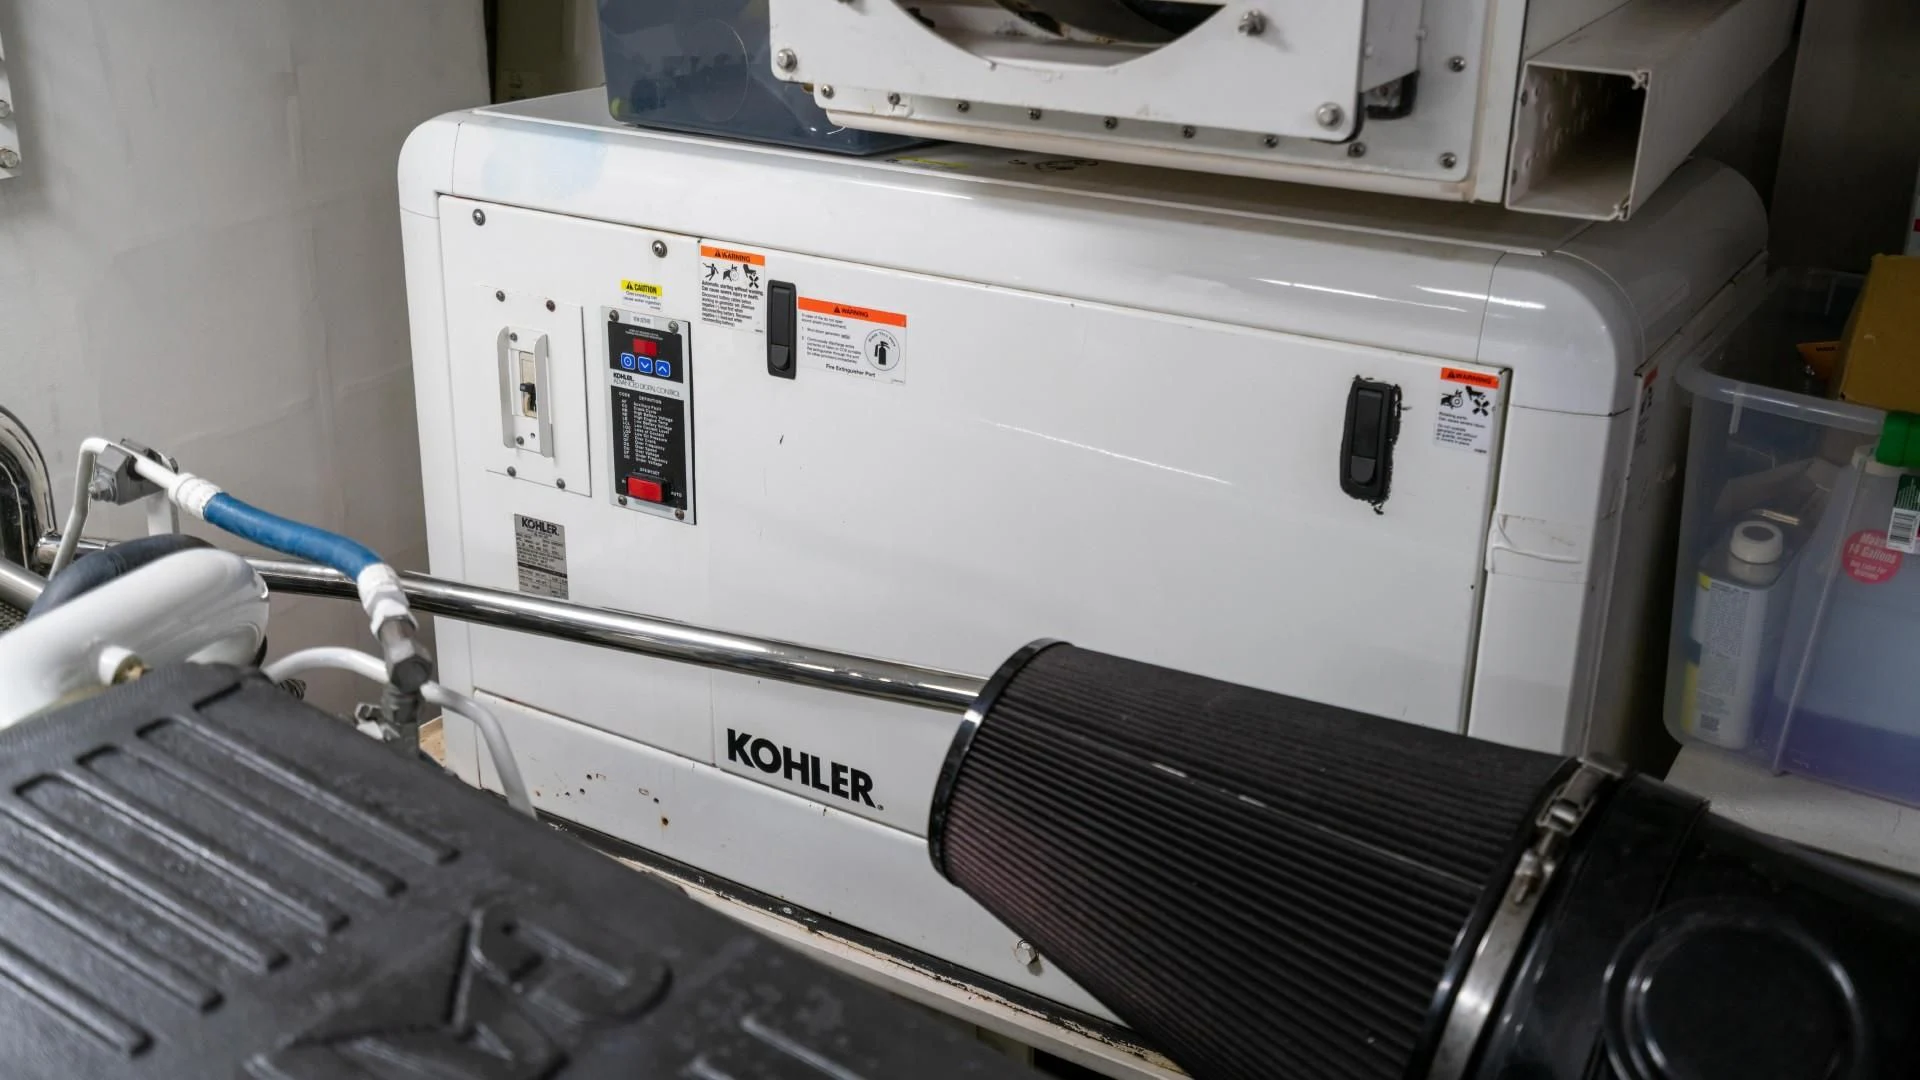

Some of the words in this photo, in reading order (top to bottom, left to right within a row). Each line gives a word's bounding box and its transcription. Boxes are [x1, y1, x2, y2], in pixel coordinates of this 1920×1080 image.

[722, 251, 750, 263] WARNING
[634, 284, 657, 294] CAUTION
[841, 308, 868, 318] WARNING
[836, 365, 864, 376] Extinguisher
[1456, 372, 1492, 384] WARNING
[522, 516, 558, 536] KOHLER
[1860, 532, 1887, 548] Make
[1860, 546, 1897, 564] Gallons
[727, 728, 876, 808] KOHLER
